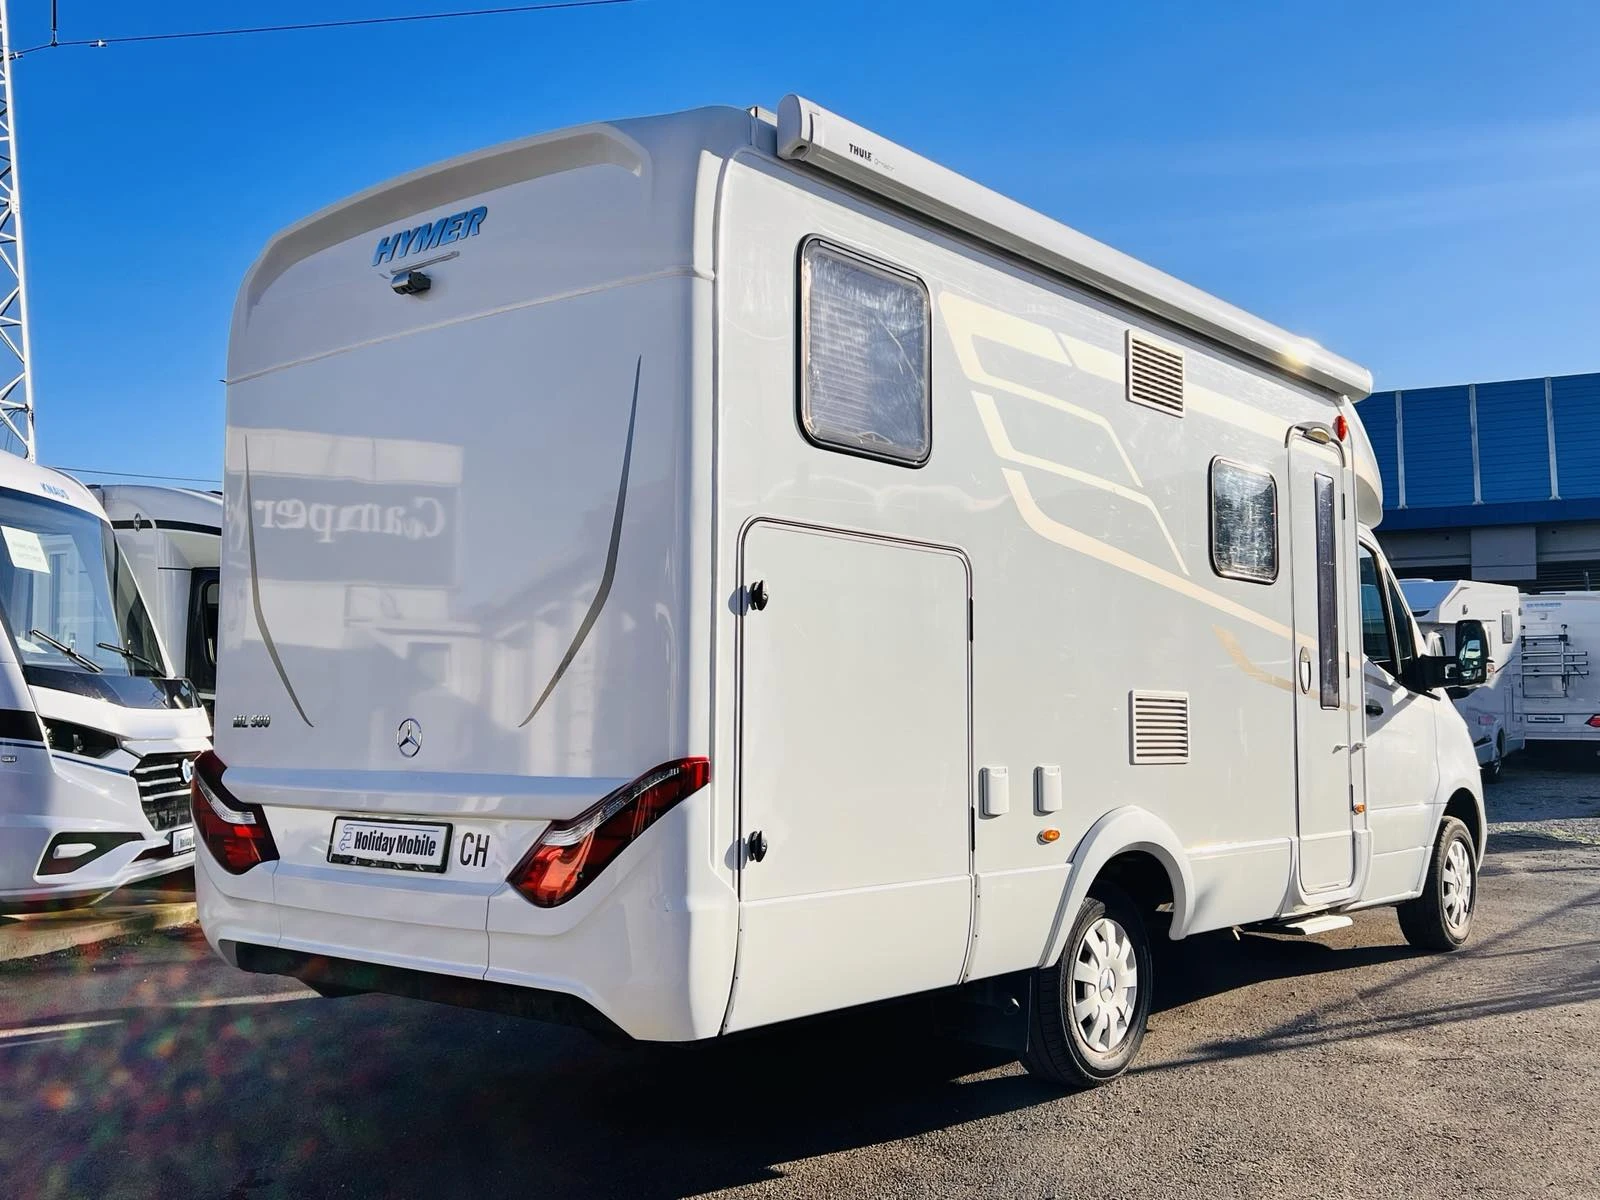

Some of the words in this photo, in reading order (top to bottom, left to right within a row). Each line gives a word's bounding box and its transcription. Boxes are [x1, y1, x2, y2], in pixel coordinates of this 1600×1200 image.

[848, 143, 872, 162] THULE
[371, 206, 488, 267] HYMER
[354, 830, 396, 856] Holiday
[396, 834, 437, 857] Mobile
[460, 832, 490, 868] CH
